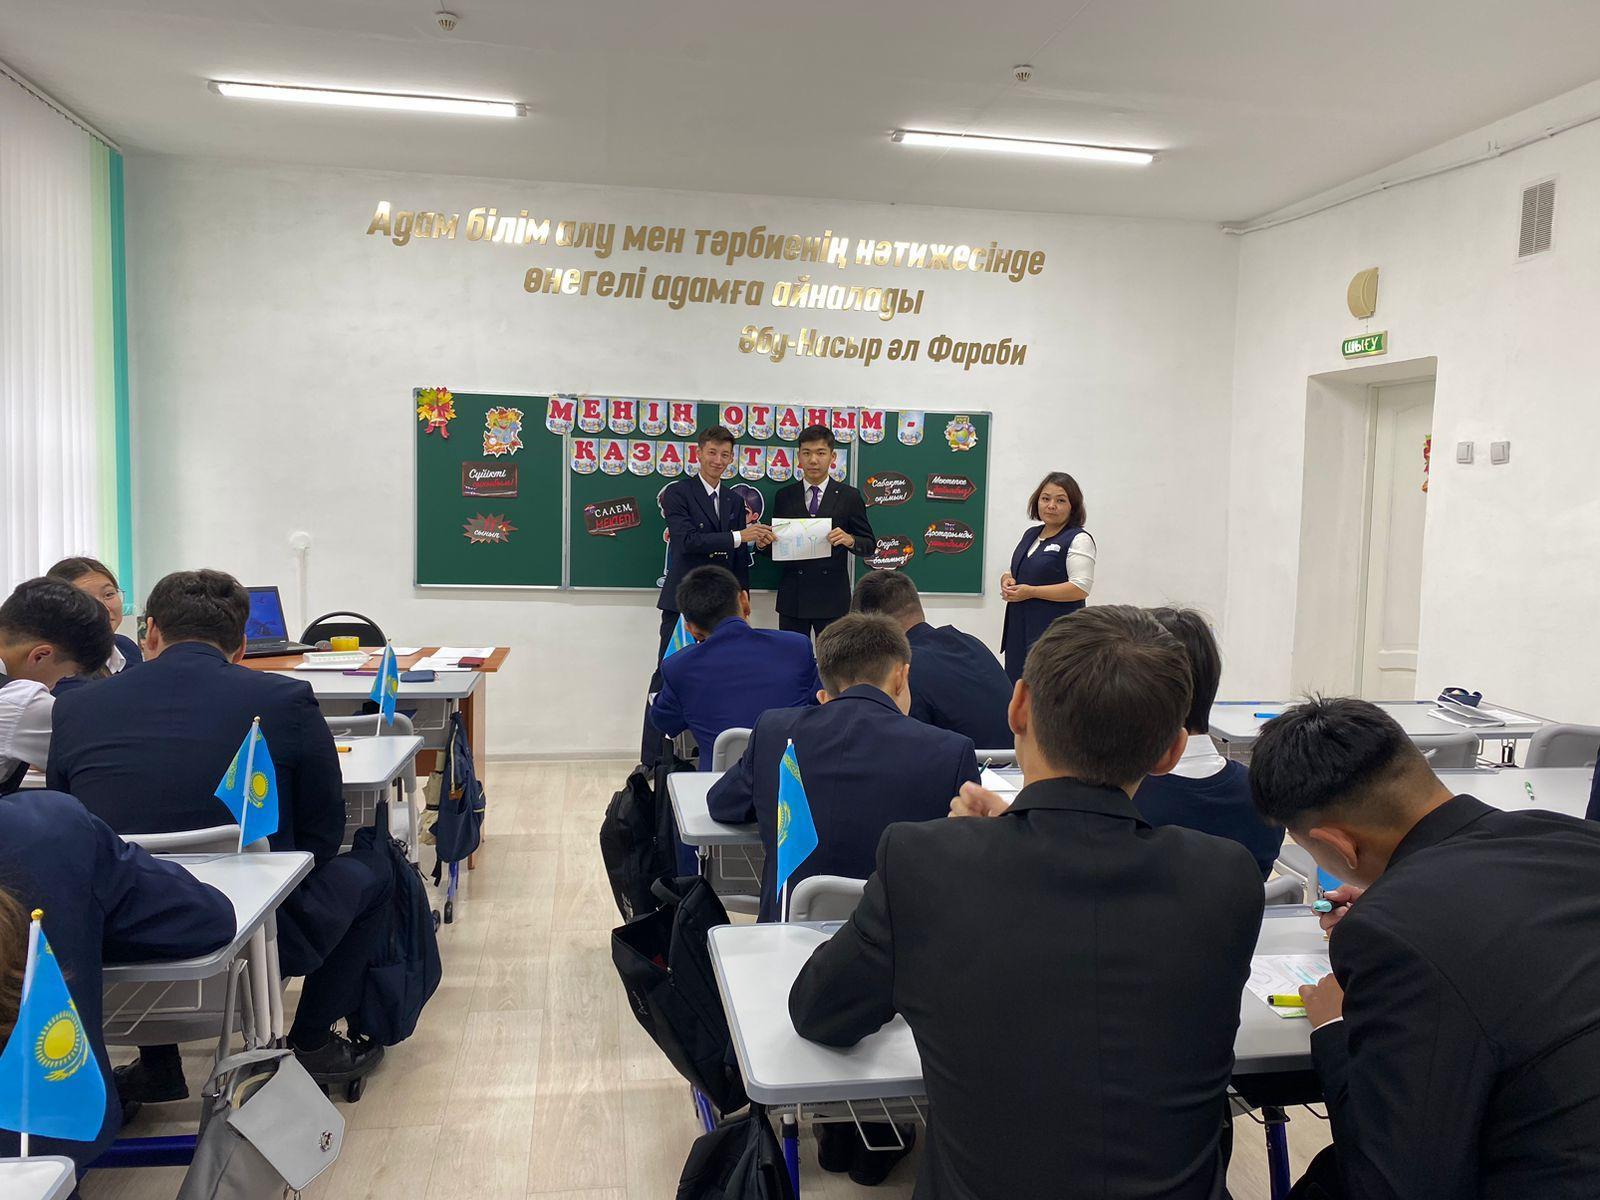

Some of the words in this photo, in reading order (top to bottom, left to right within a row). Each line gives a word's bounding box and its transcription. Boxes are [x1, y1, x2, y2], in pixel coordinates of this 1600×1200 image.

[366, 200, 461, 247] Адам
[464, 206, 552, 246] білім
[554, 219, 617, 259] алу
[622, 224, 686, 254] мен
[694, 225, 849, 270] тәрбиенің
[855, 236, 1046, 283] нәтижесінде
[523, 265, 649, 299] өнегелі
[651, 273, 765, 311] адамға
[771, 274, 925, 322] айналады
[737, 324, 883, 368] Әбу-Насыр
[887, 338, 921, 362] әл
[926, 334, 1028, 371] Фараби
[549, 399, 695, 425] МЕНІҢ
[724, 405, 883, 430] ОТАНЫМ
